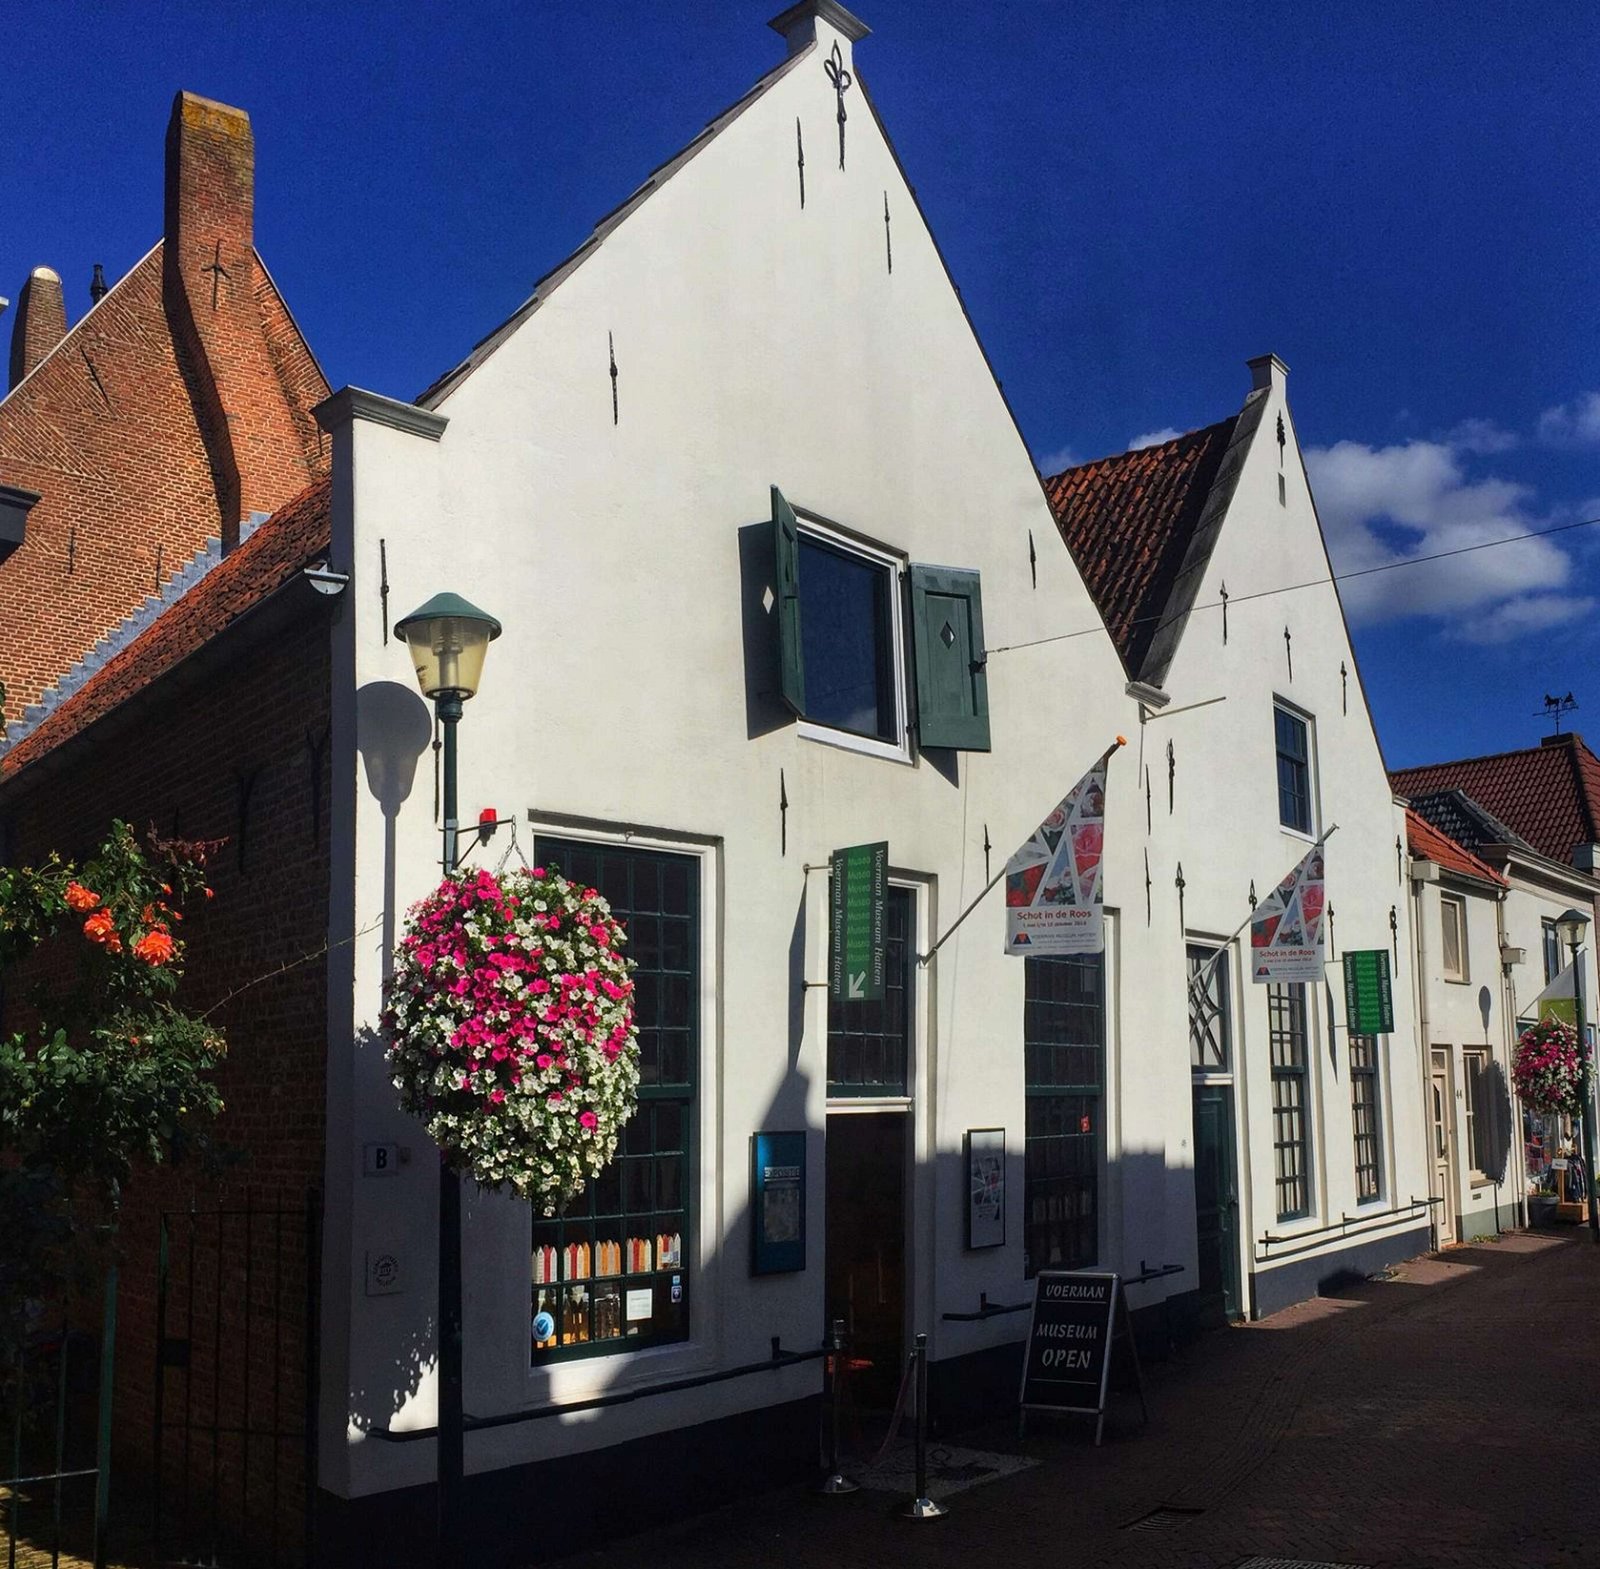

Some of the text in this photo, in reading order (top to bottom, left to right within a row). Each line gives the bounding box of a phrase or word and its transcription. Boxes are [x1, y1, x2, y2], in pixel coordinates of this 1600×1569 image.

[874, 849, 884, 985] Voerman Museum Hattem
[1017, 910, 1092, 920] Schot in de Roos
[834, 858, 843, 994] Voerman Museum Hattem
[376, 1148, 387, 1169] B
[1046, 1285, 1105, 1298] VOERMAN
[1036, 1323, 1097, 1339] MUSEUM
[1042, 1348, 1091, 1369] OPEN
